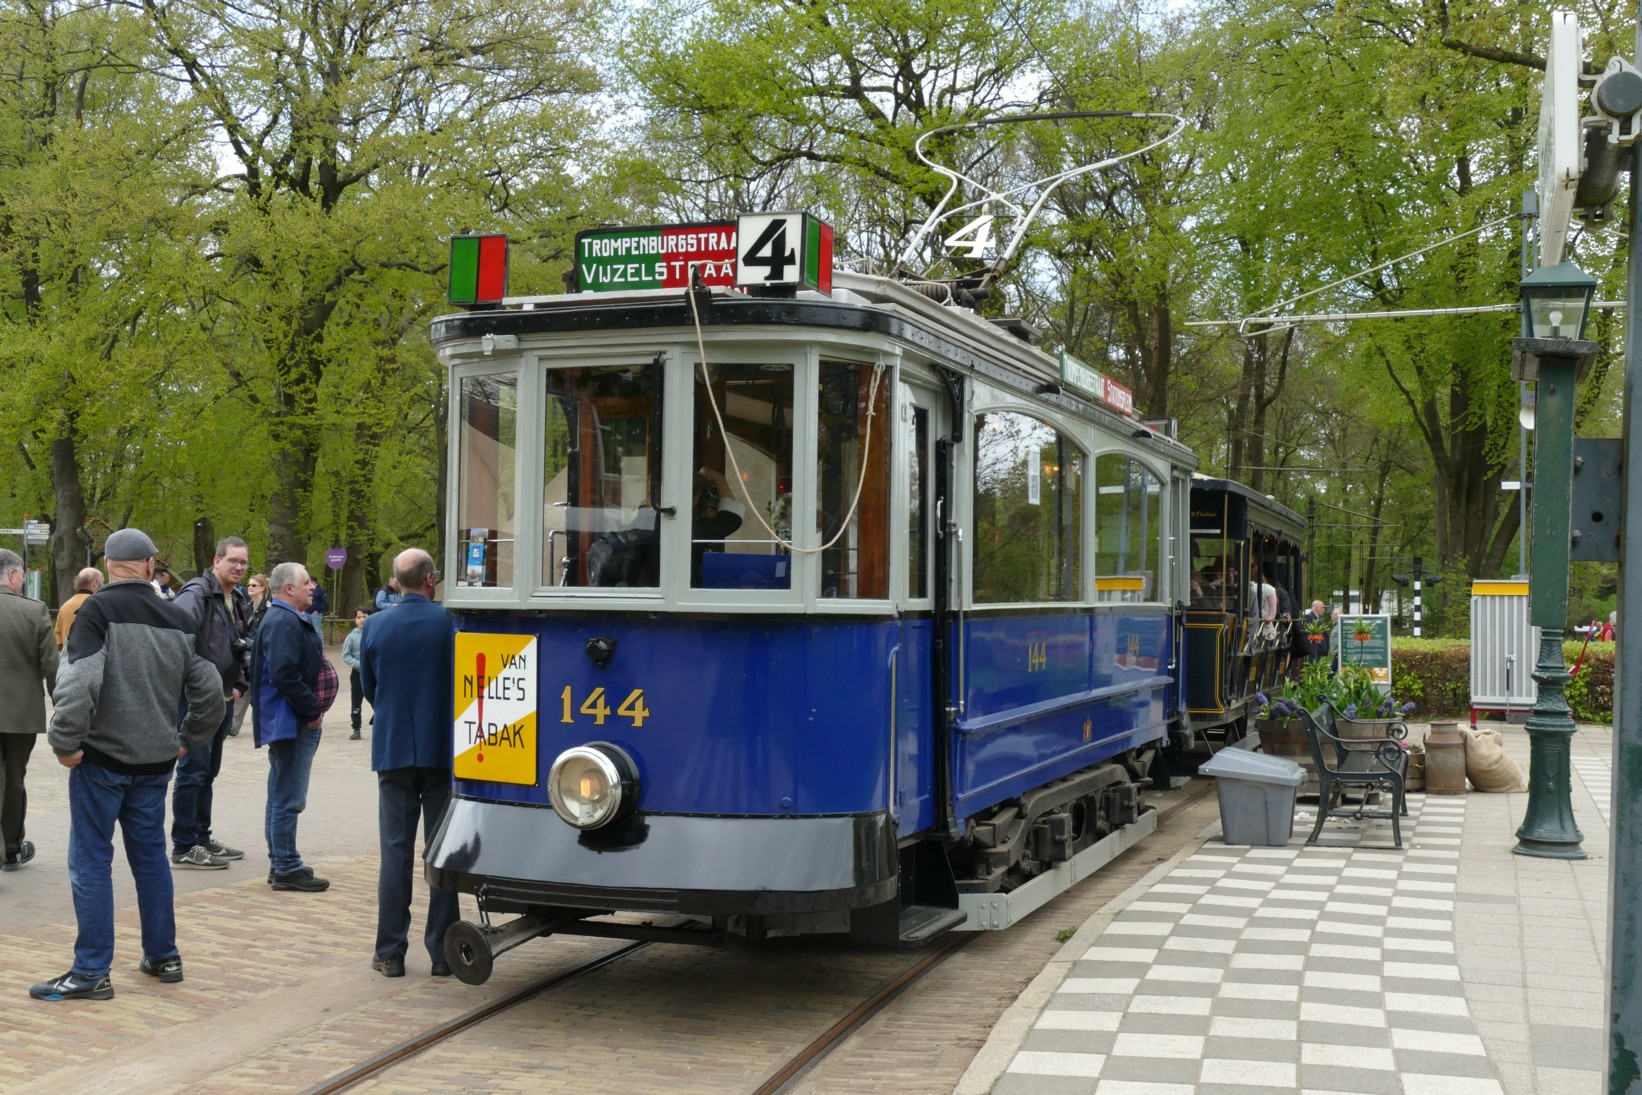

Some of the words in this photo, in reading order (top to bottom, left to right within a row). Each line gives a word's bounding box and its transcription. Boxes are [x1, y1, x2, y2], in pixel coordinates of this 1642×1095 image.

[741, 218, 797, 281] 4
[944, 214, 996, 258] 4
[501, 653, 527, 670] VAN
[1028, 641, 1047, 672] 144
[463, 674, 526, 702] NELLE'S
[560, 685, 650, 727] 144
[463, 720, 525, 749] TABAK
